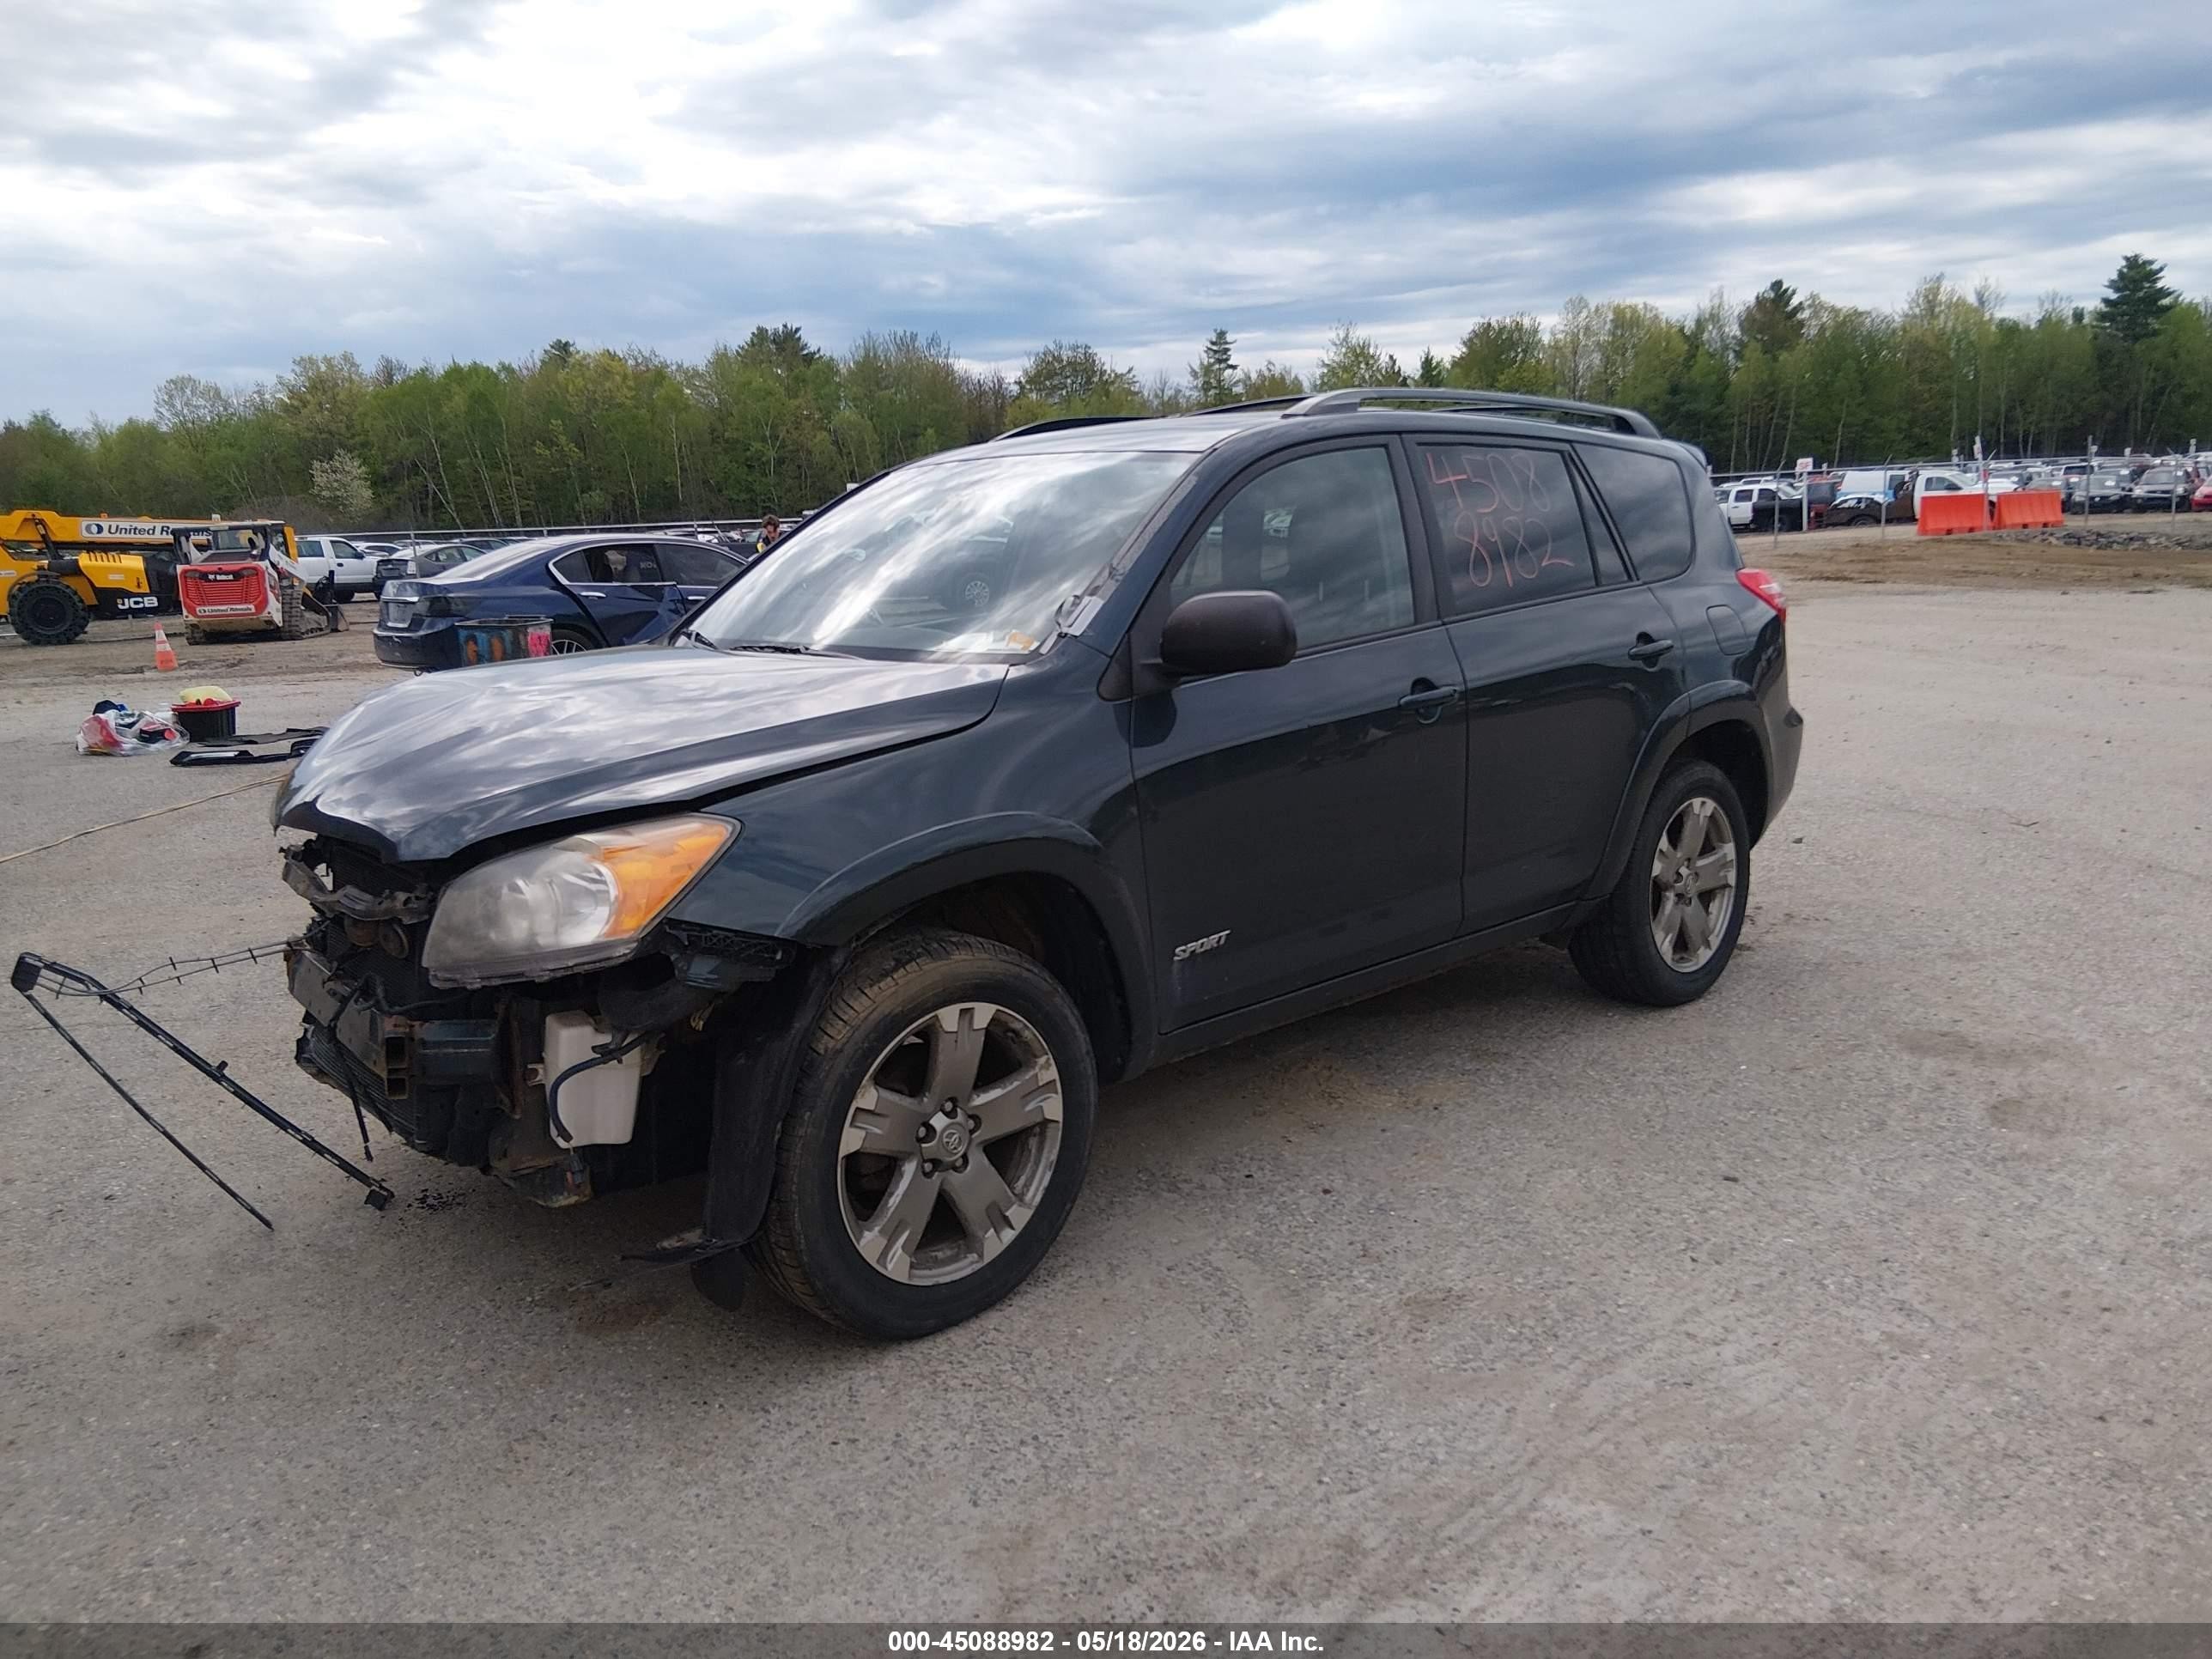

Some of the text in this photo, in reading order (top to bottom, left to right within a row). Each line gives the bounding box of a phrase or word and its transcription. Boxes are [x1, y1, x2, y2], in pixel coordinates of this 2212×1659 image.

[1426, 453, 1552, 513] 4508
[107, 524, 156, 536] United
[1454, 510, 1575, 588] 8982
[117, 596, 159, 610] JCB
[1173, 929, 1231, 961] SPORT
